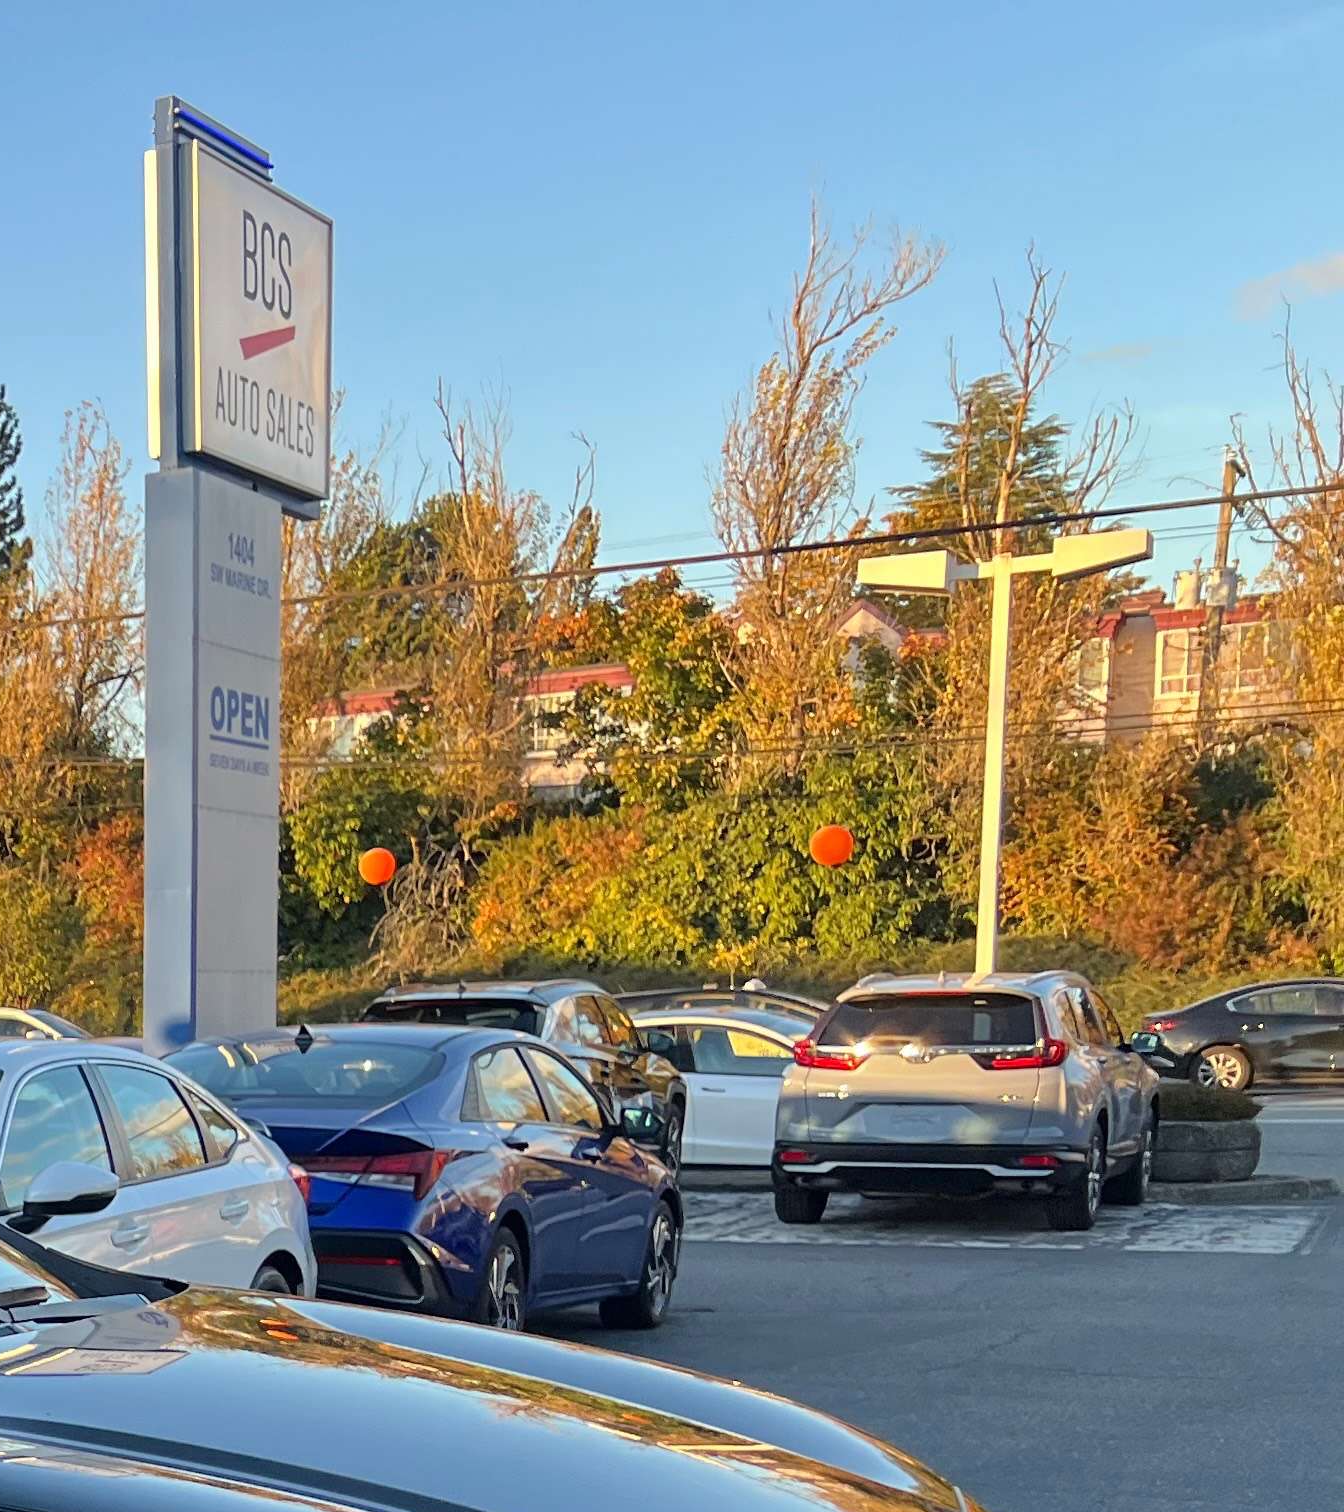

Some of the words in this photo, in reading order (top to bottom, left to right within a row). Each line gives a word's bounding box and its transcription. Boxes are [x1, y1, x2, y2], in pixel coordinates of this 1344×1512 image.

[242, 209, 293, 320] BCS
[215, 365, 260, 437] AUTO
[266, 386, 314, 458] SALES
[227, 531, 255, 568] 1404
[210, 685, 269, 741] OPEN
